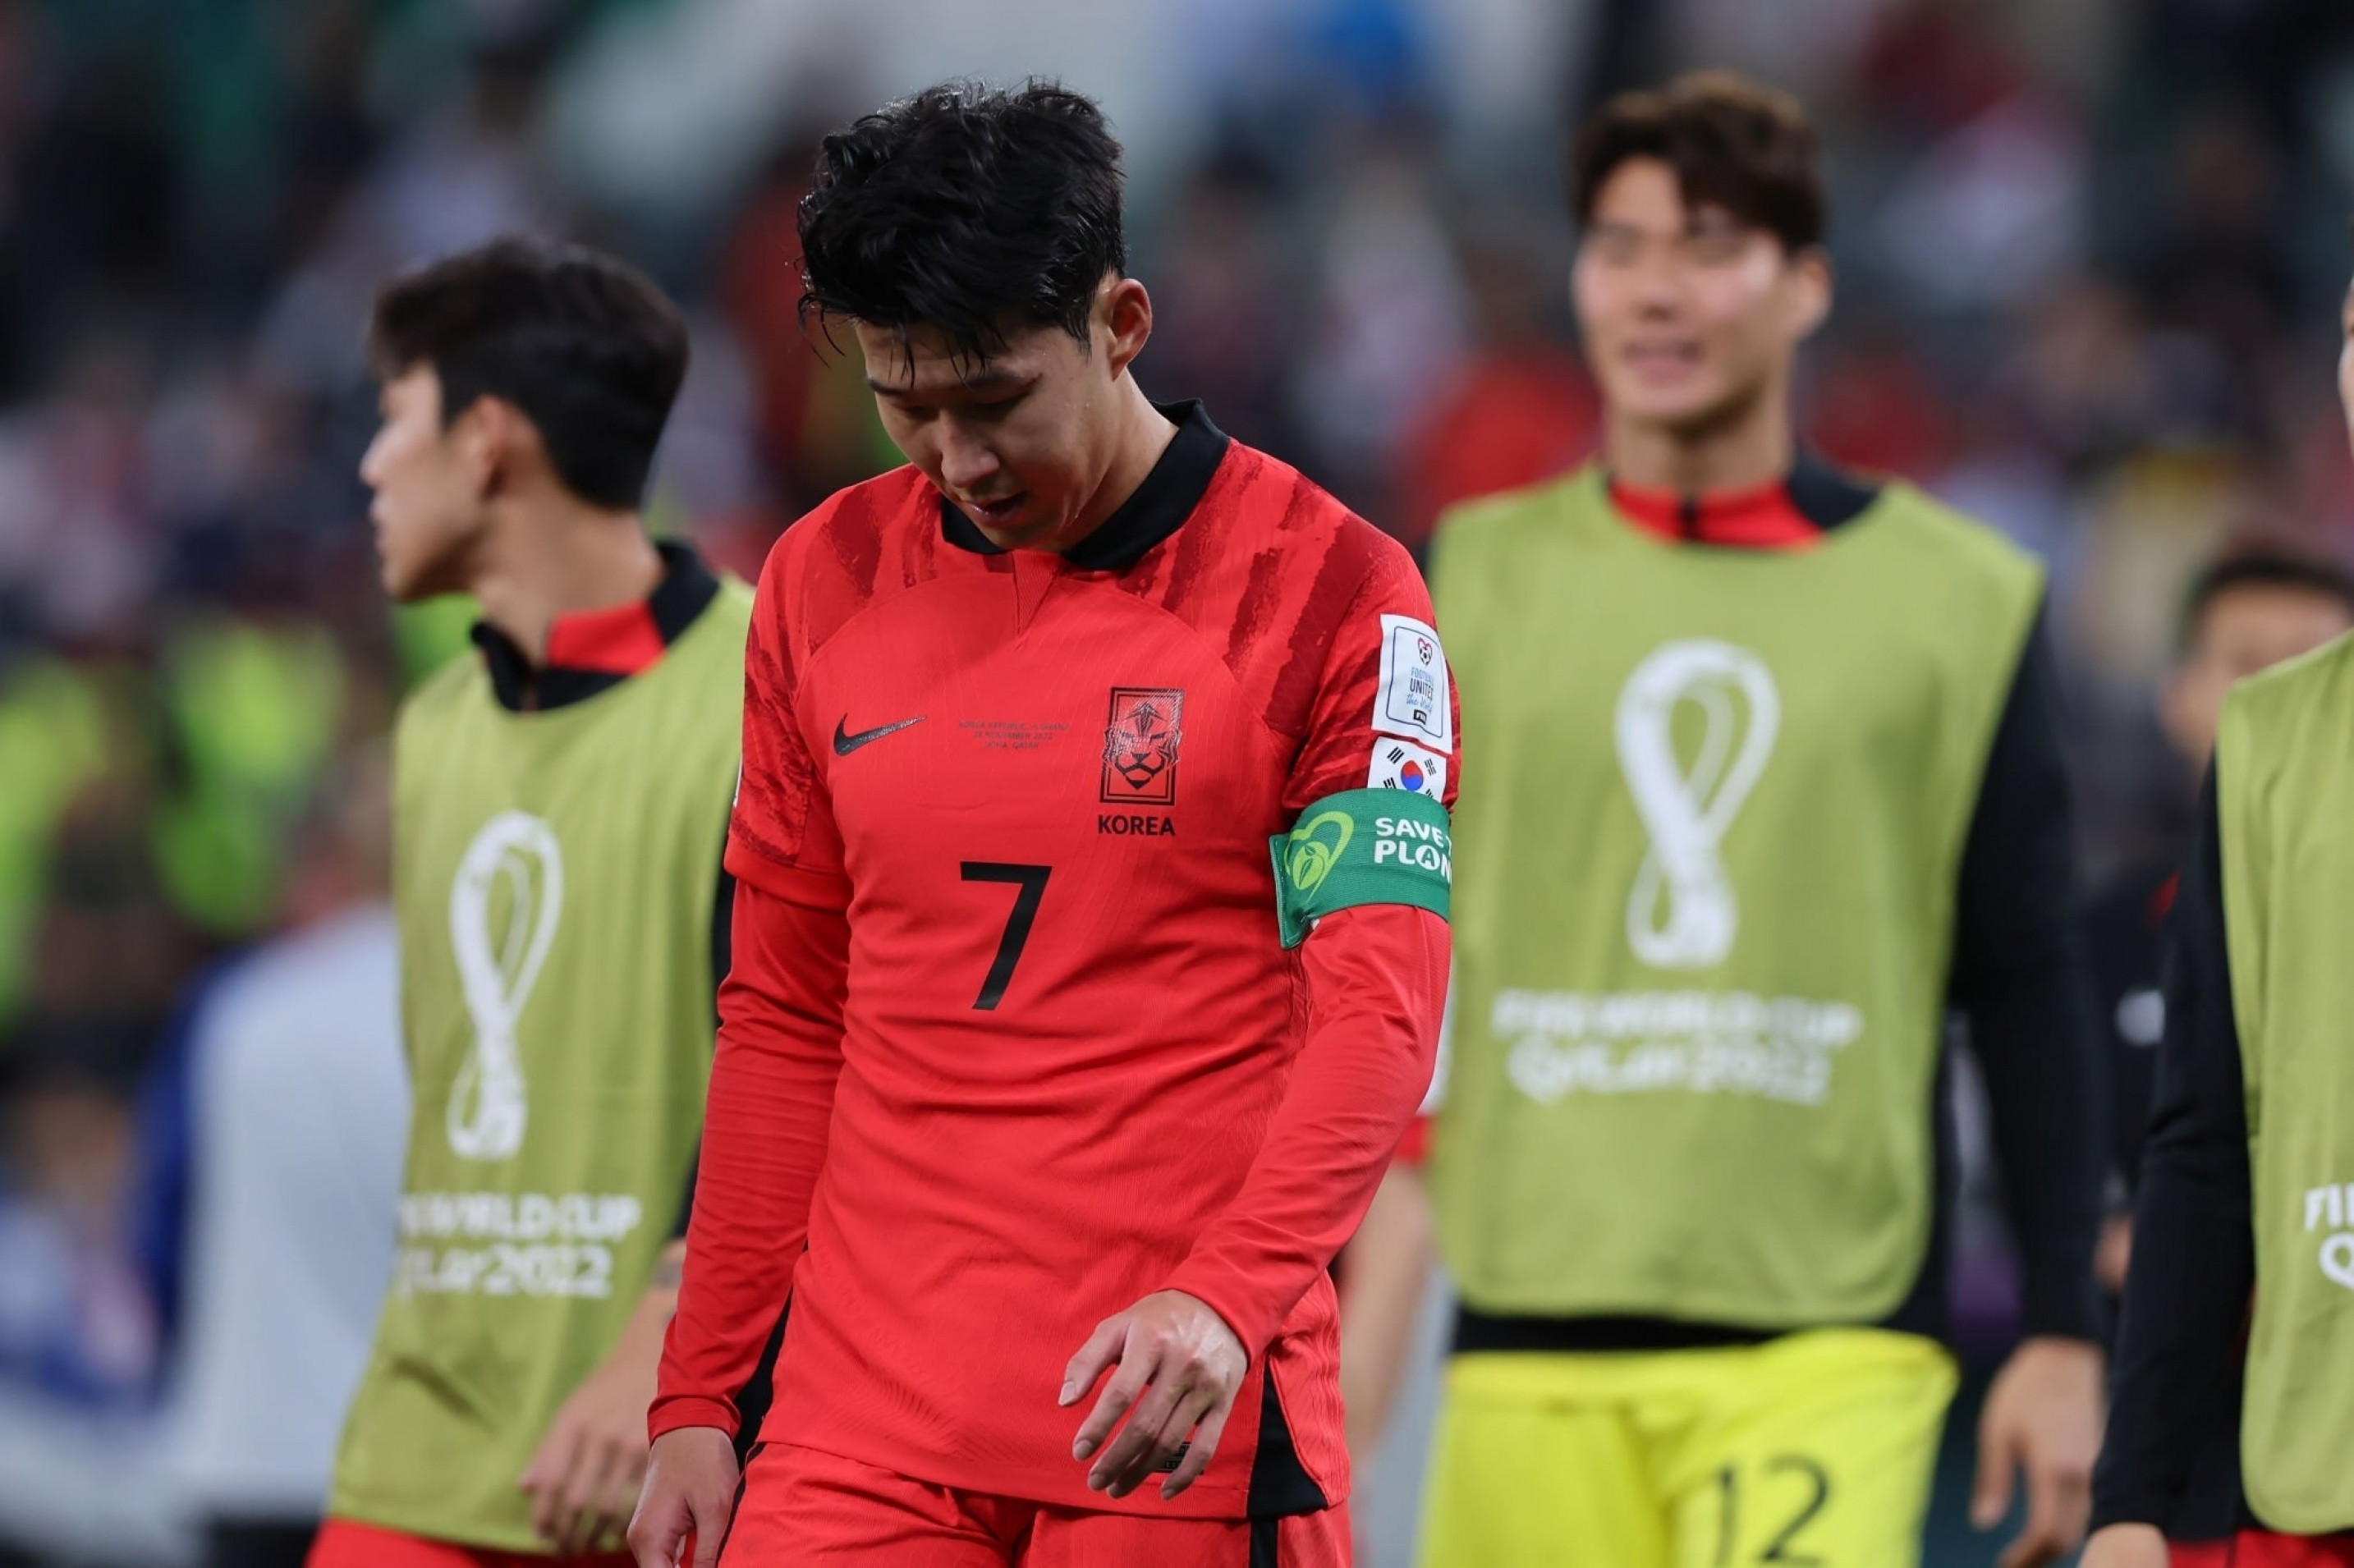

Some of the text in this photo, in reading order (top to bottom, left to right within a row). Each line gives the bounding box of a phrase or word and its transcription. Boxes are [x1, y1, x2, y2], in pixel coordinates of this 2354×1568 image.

[1097, 814, 1176, 837] KOREA
[1374, 817, 1444, 849] SAVE
[959, 860, 1053, 1011] 7
[1714, 1451, 1829, 1568] 12
